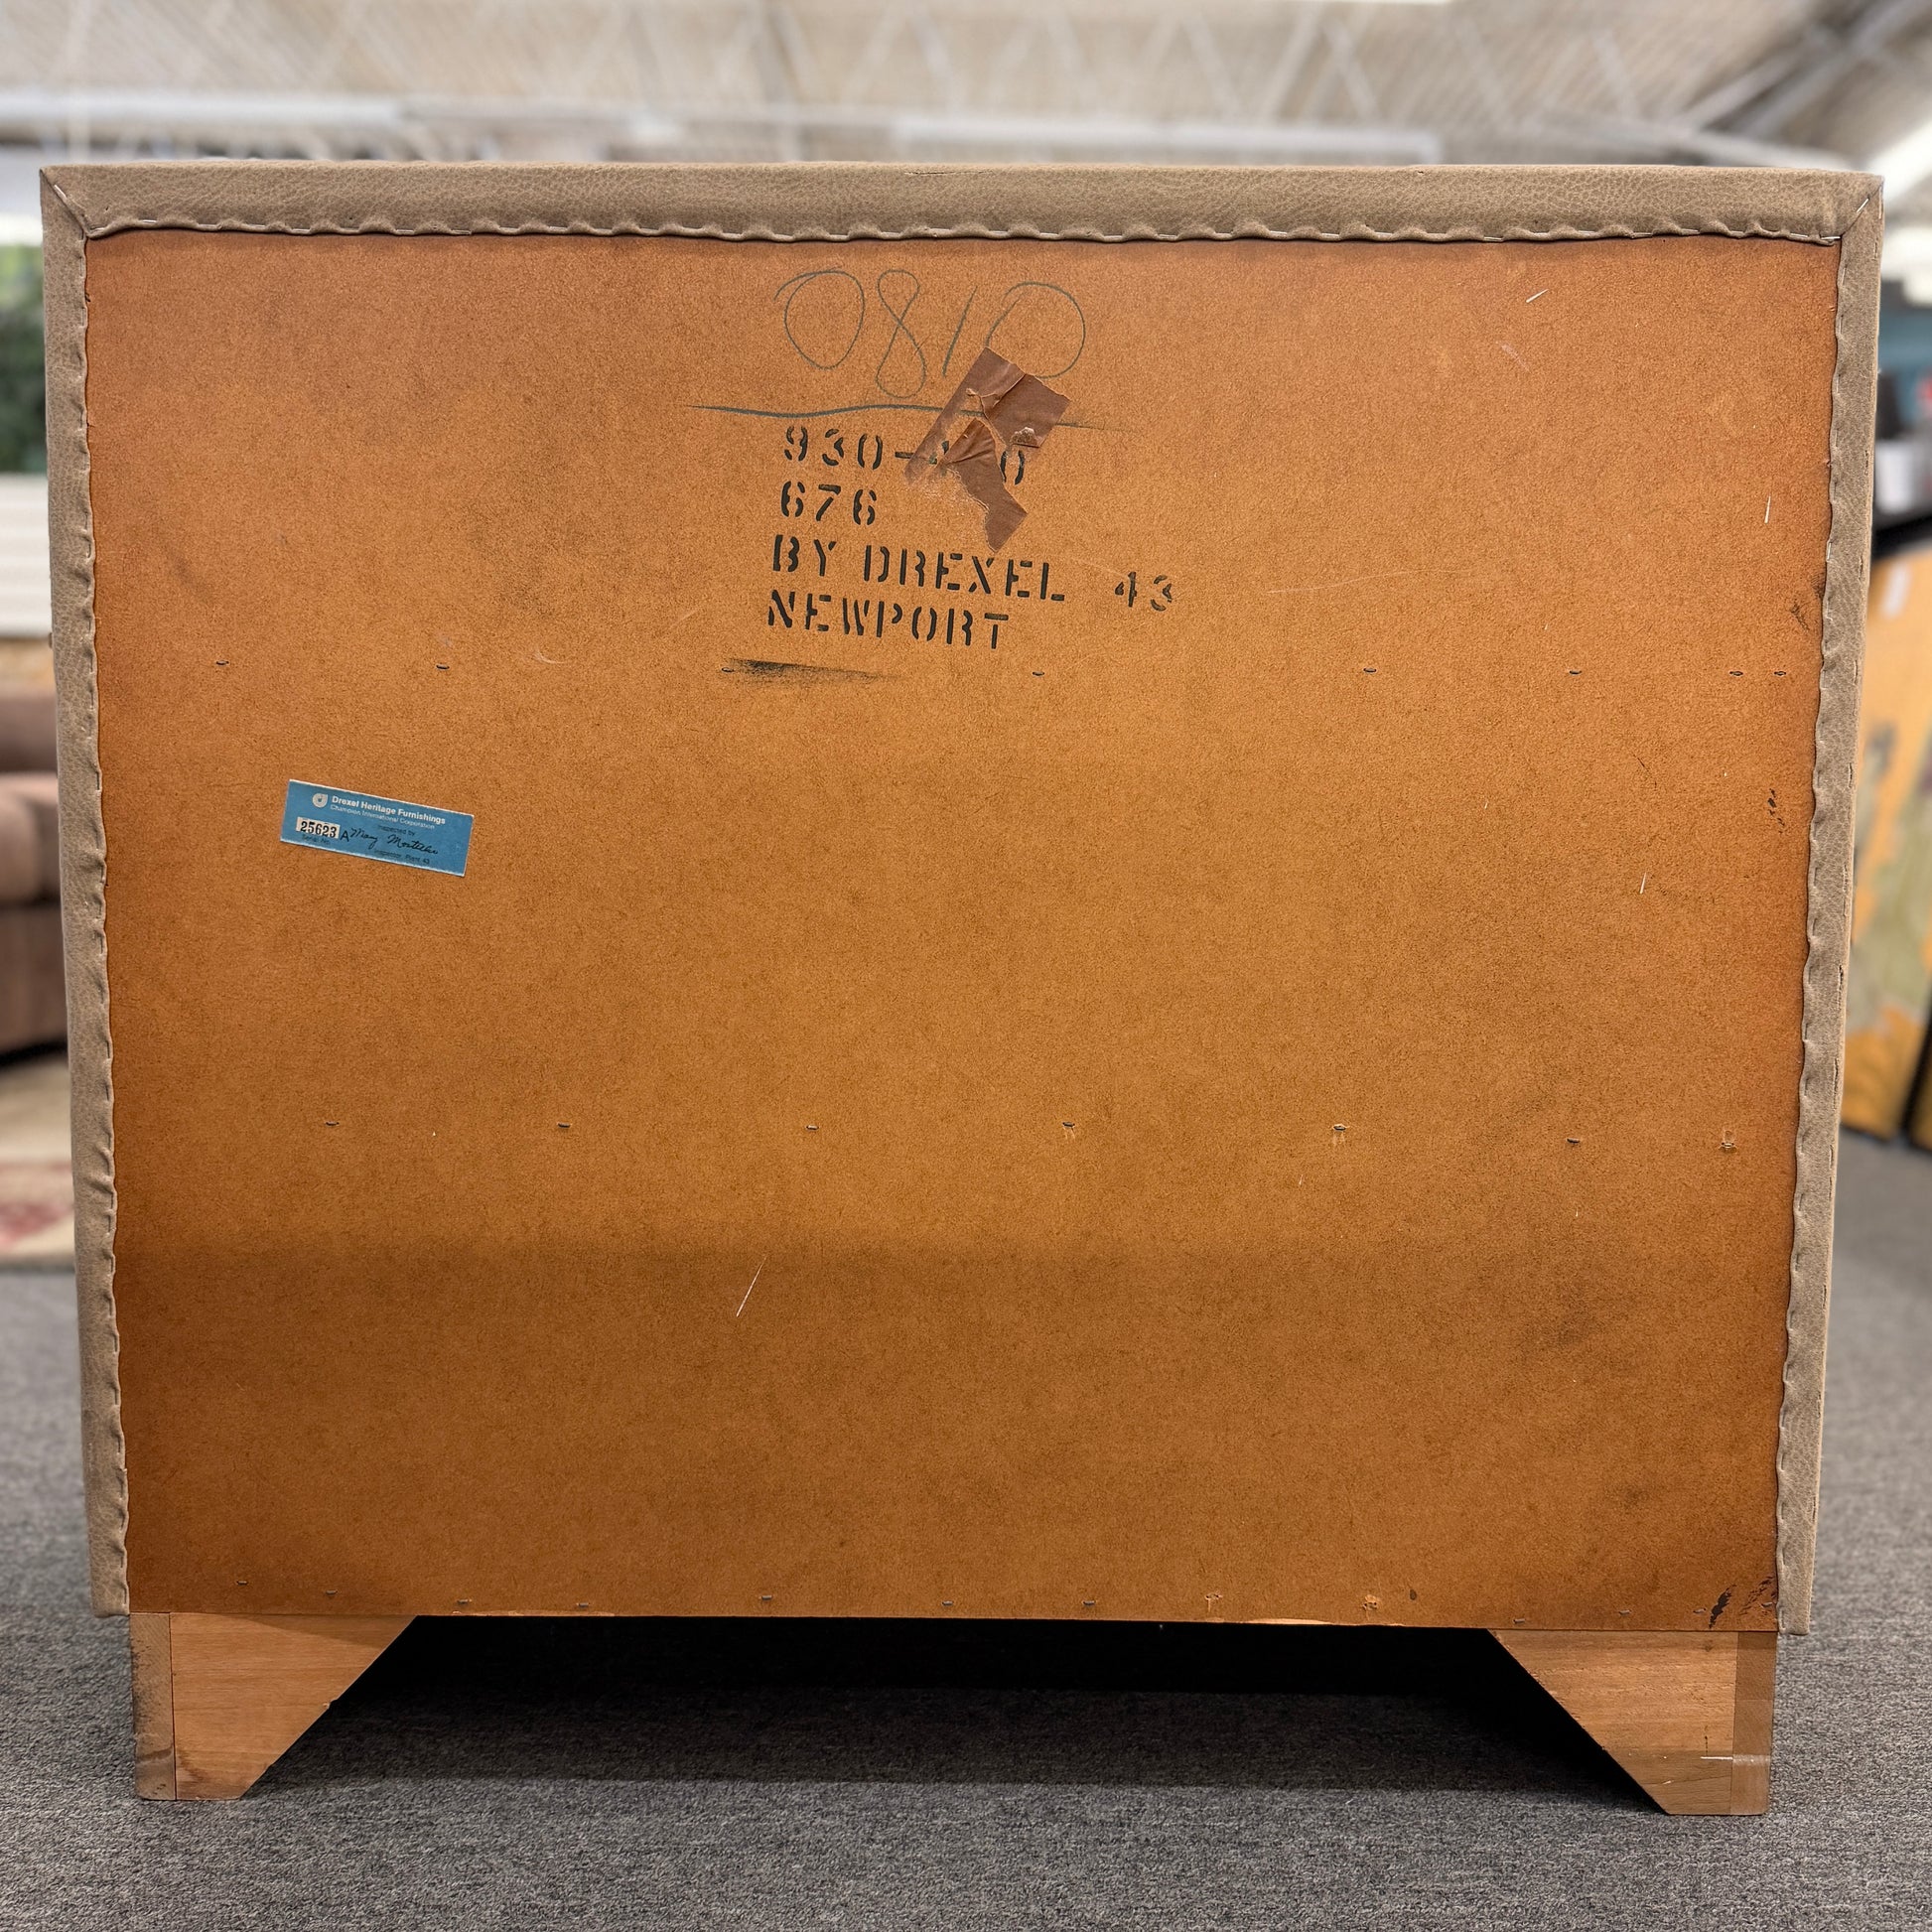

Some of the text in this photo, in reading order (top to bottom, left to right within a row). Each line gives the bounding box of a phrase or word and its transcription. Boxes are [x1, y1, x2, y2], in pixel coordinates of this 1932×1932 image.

[774, 265, 1086, 398] 0810
[783, 425, 1026, 485] 930-0
[779, 481, 879, 526] 676
[772, 534, 1066, 603] BY DREXEL
[1114, 570, 1173, 613] 43
[766, 590, 1011, 650] NEWPORT
[300, 820, 349, 843] 25623 A
[331, 795, 446, 825] Drexel Heritage Furnishings
